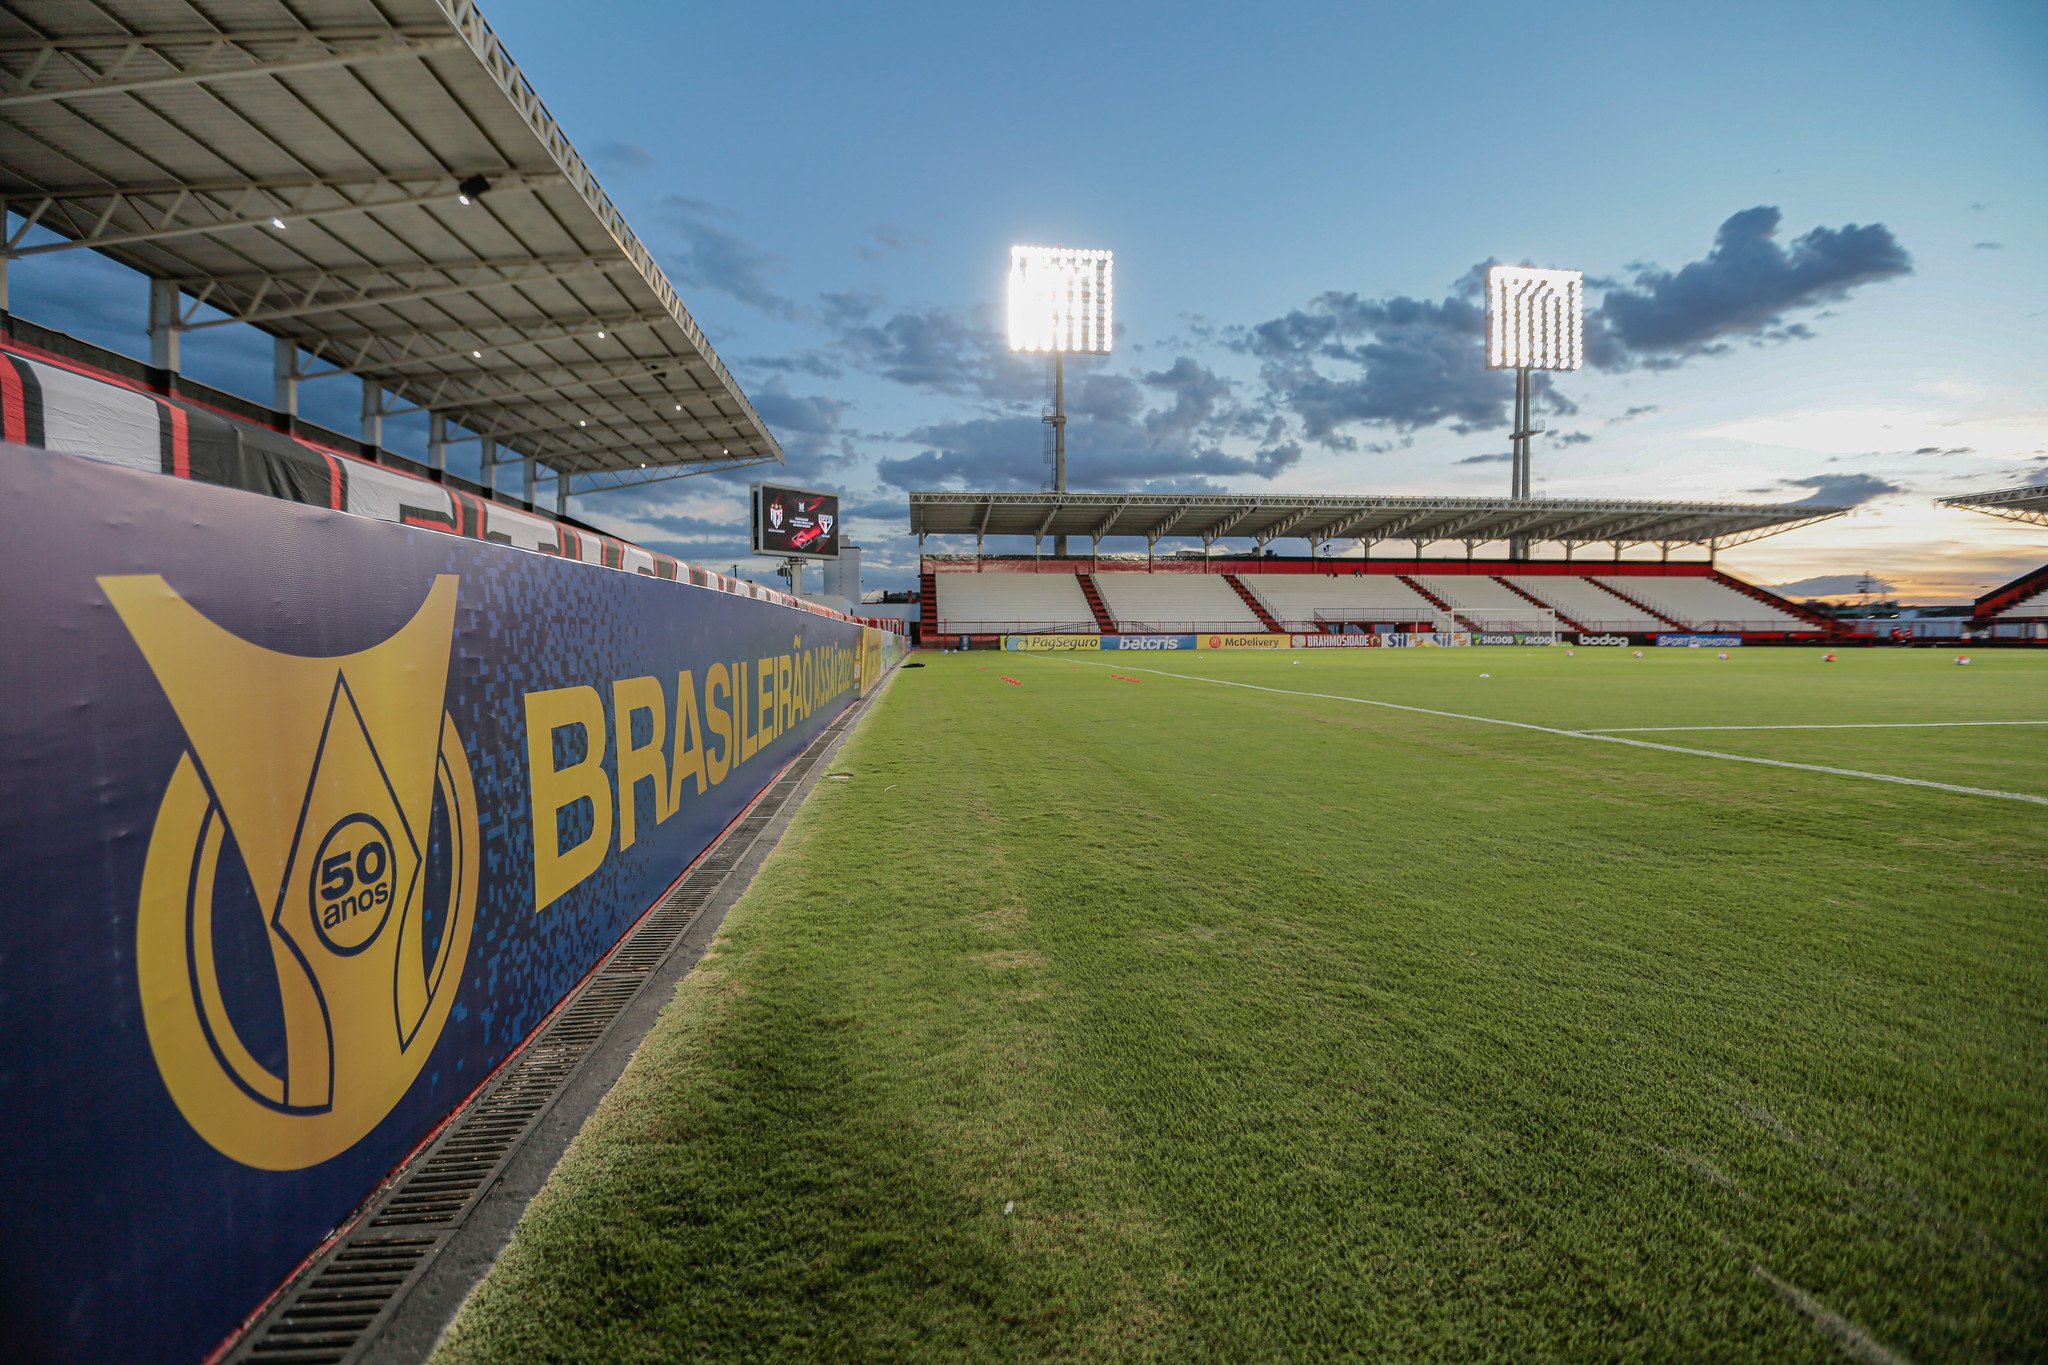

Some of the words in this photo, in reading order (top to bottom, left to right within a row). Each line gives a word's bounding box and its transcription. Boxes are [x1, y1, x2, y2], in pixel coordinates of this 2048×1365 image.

[1032, 637, 1098, 650] PagSeguro
[1119, 635, 1178, 650] betcris
[1225, 636, 1279, 648] McDelivery
[1307, 635, 1369, 647] BRAHMOSIDADE
[1387, 633, 1408, 648] Sil
[1482, 635, 1514, 645] SICOOB
[1525, 635, 1557, 645] SICOO
[1578, 633, 1629, 648] bodog
[524, 634, 812, 914] BRASILEIRÃO
[814, 640, 838, 712] ASSAÍ
[320, 841, 387, 901] 50
[323, 882, 389, 930] anos
